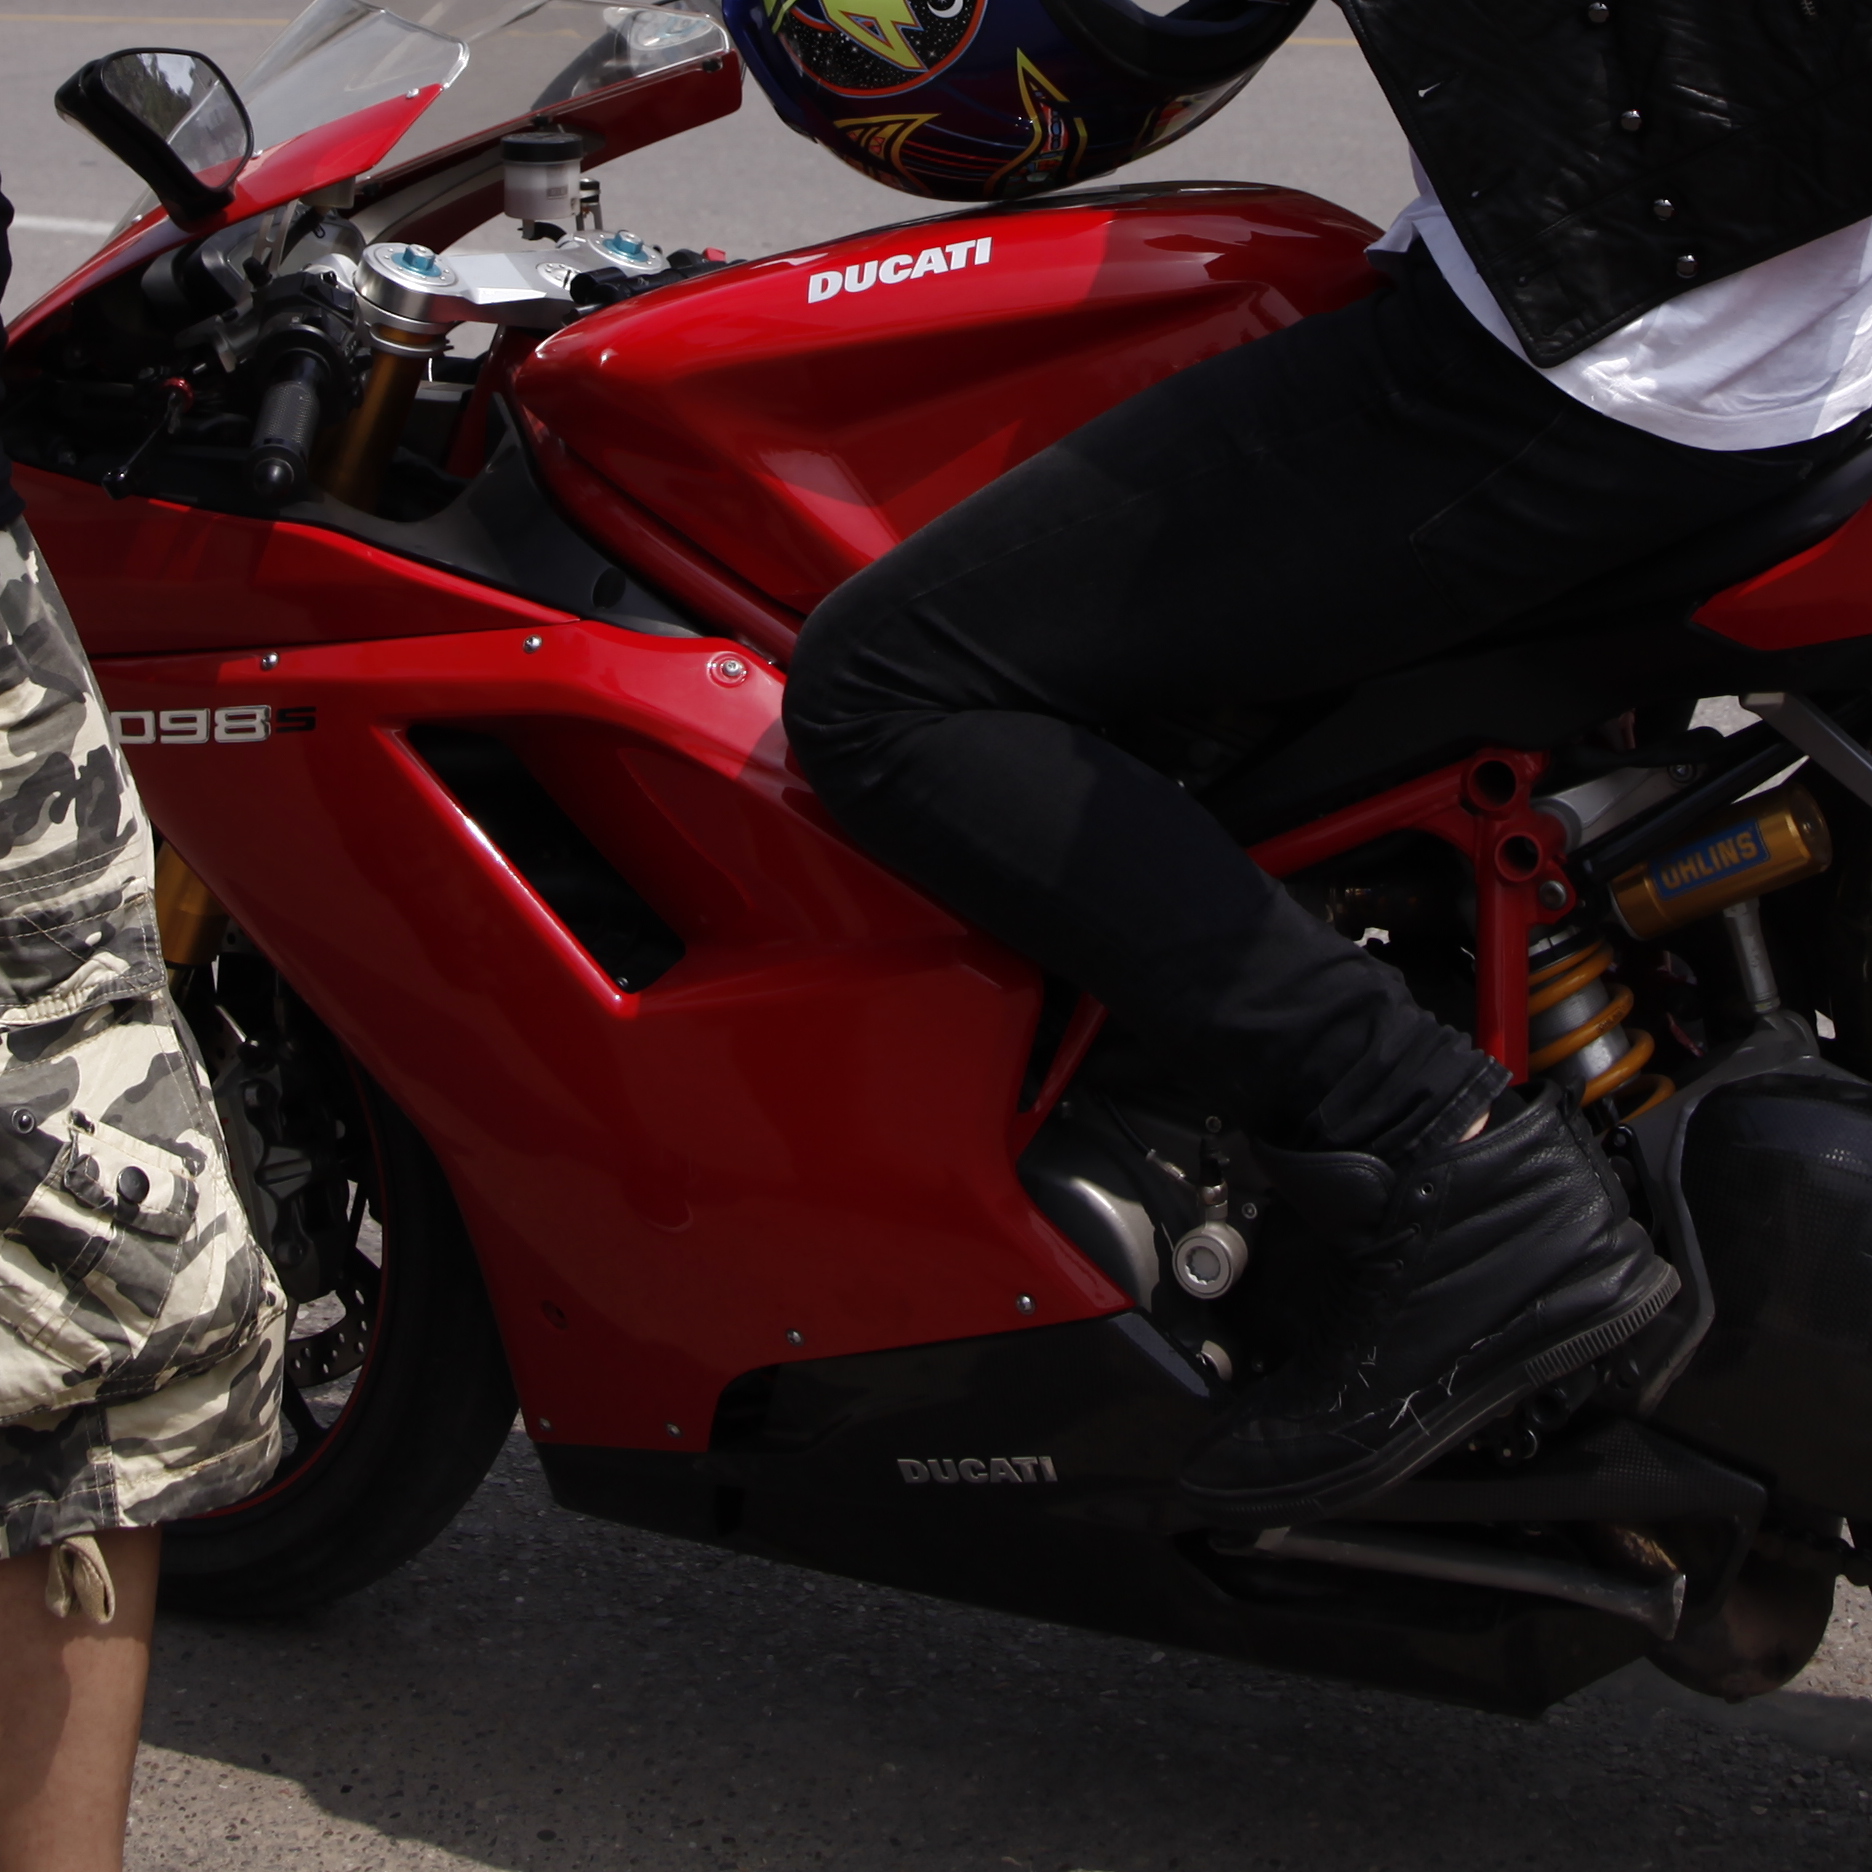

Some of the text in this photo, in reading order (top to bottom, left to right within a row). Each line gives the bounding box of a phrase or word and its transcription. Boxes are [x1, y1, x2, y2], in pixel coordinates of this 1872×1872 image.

[808, 237, 993, 303] DUCATI
[110, 704, 316, 745] 098S
[897, 1456, 1059, 1484] DUCATI
